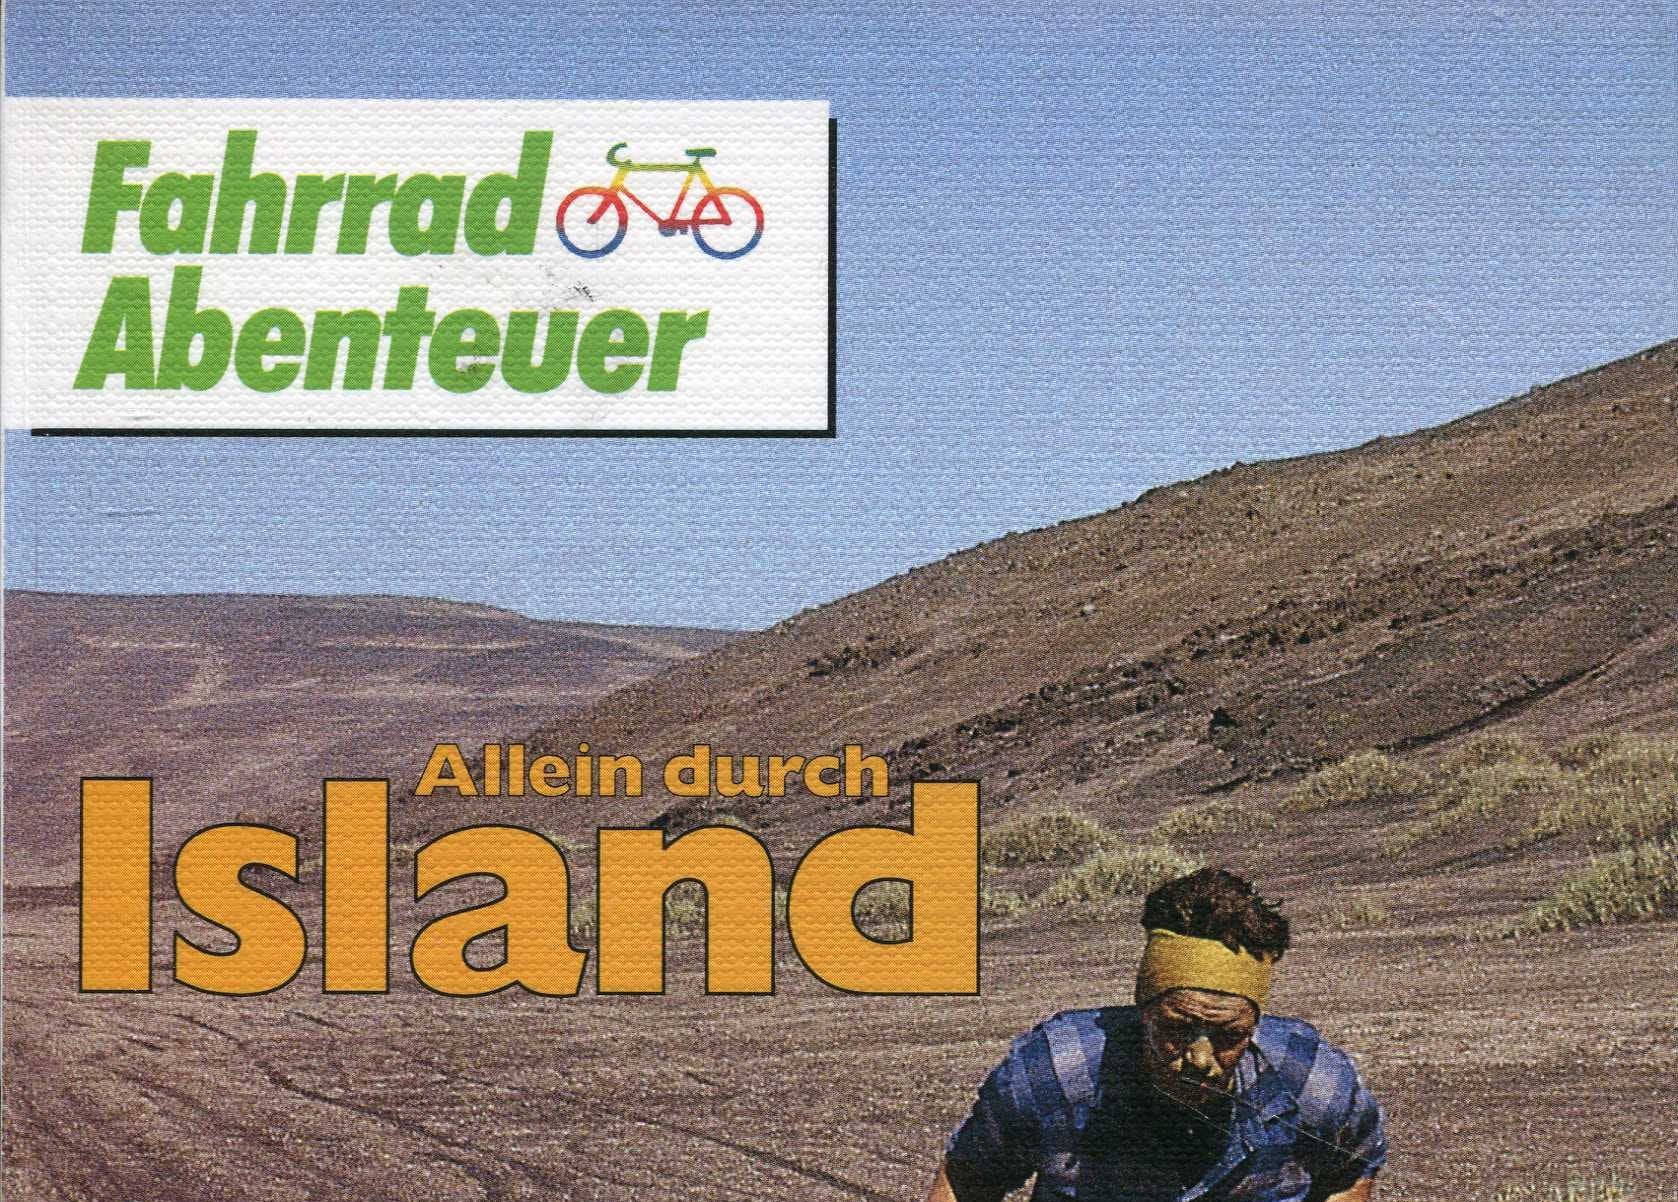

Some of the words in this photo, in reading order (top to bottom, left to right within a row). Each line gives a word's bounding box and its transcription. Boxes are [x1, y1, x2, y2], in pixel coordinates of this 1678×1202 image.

[81, 129, 554, 255] Fahrrad
[73, 265, 709, 393] Abenteuer
[415, 744, 642, 796] Allein
[664, 744, 890, 796] durch
[80, 778, 980, 997] Island
